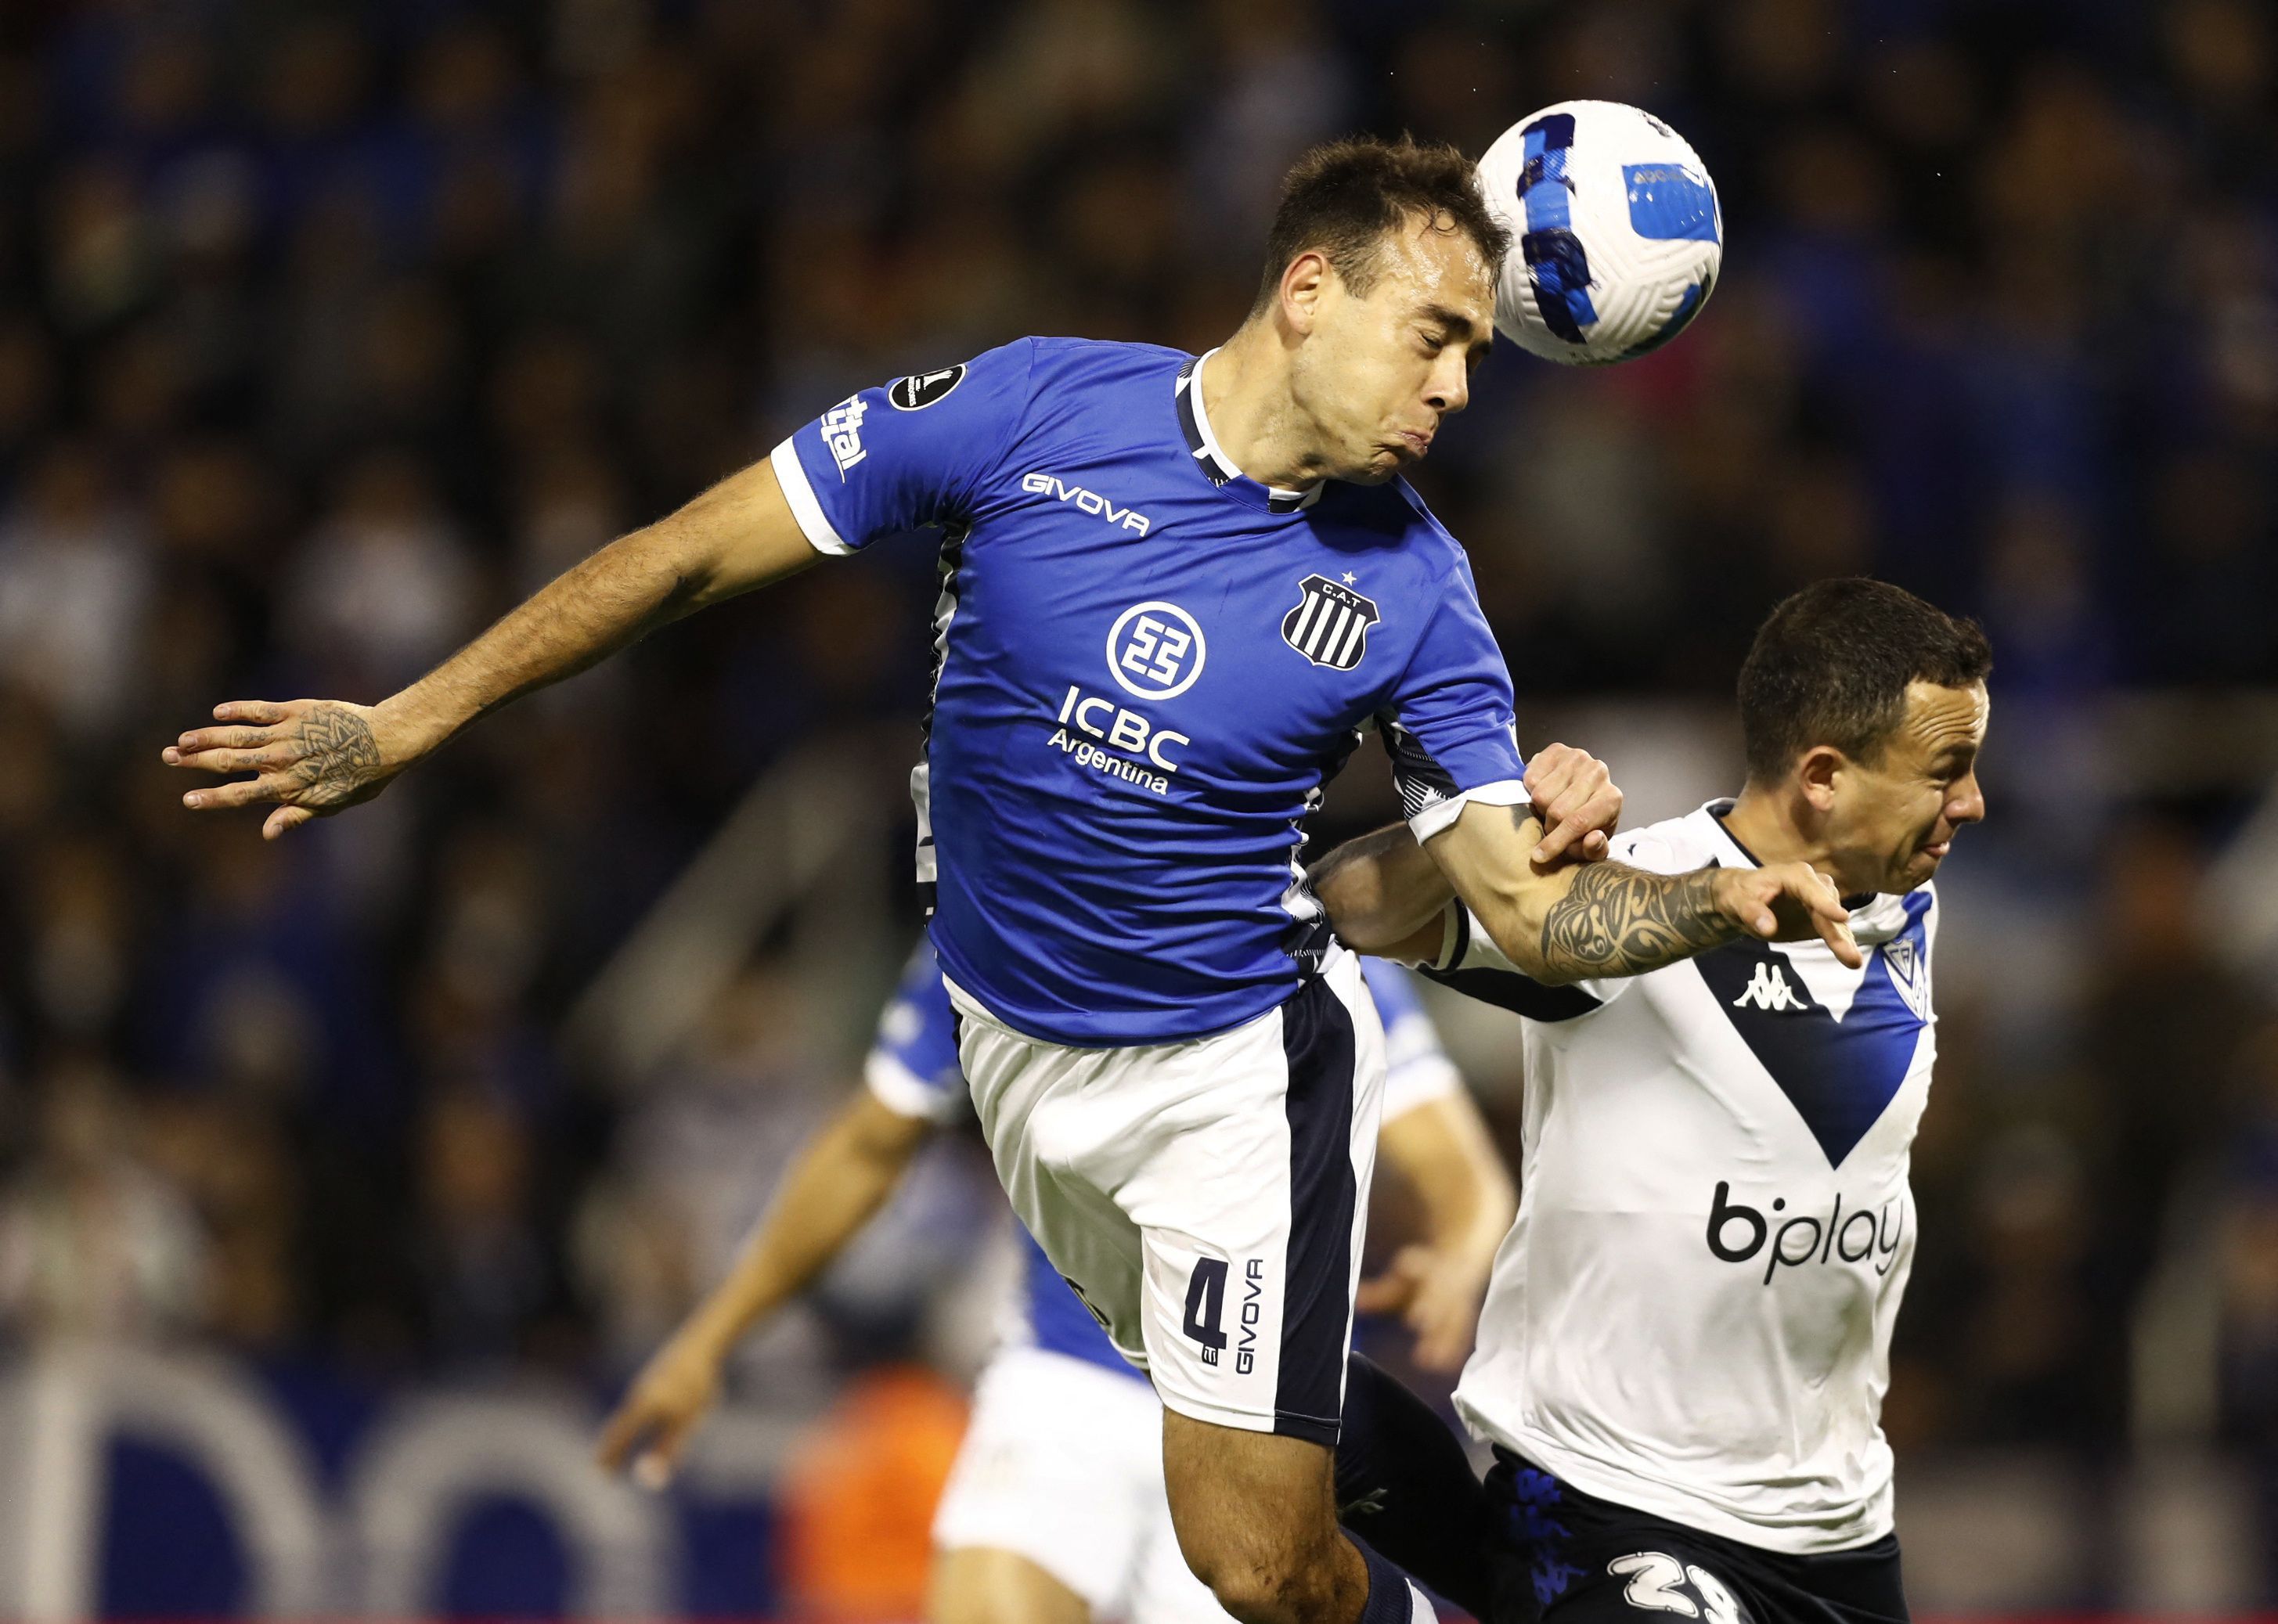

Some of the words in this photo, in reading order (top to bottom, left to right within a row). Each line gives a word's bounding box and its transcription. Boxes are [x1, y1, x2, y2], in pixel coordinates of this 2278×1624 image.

[820, 393, 868, 472] ttal
[1022, 473, 1151, 538] GIVOVA
[1322, 583, 1361, 607] C.A.T
[1047, 728, 1170, 795] Argentina
[1058, 685, 1191, 773] ICBC
[1182, 1256, 1229, 1350] 4
[1235, 1258, 1263, 1375] GIVOVA
